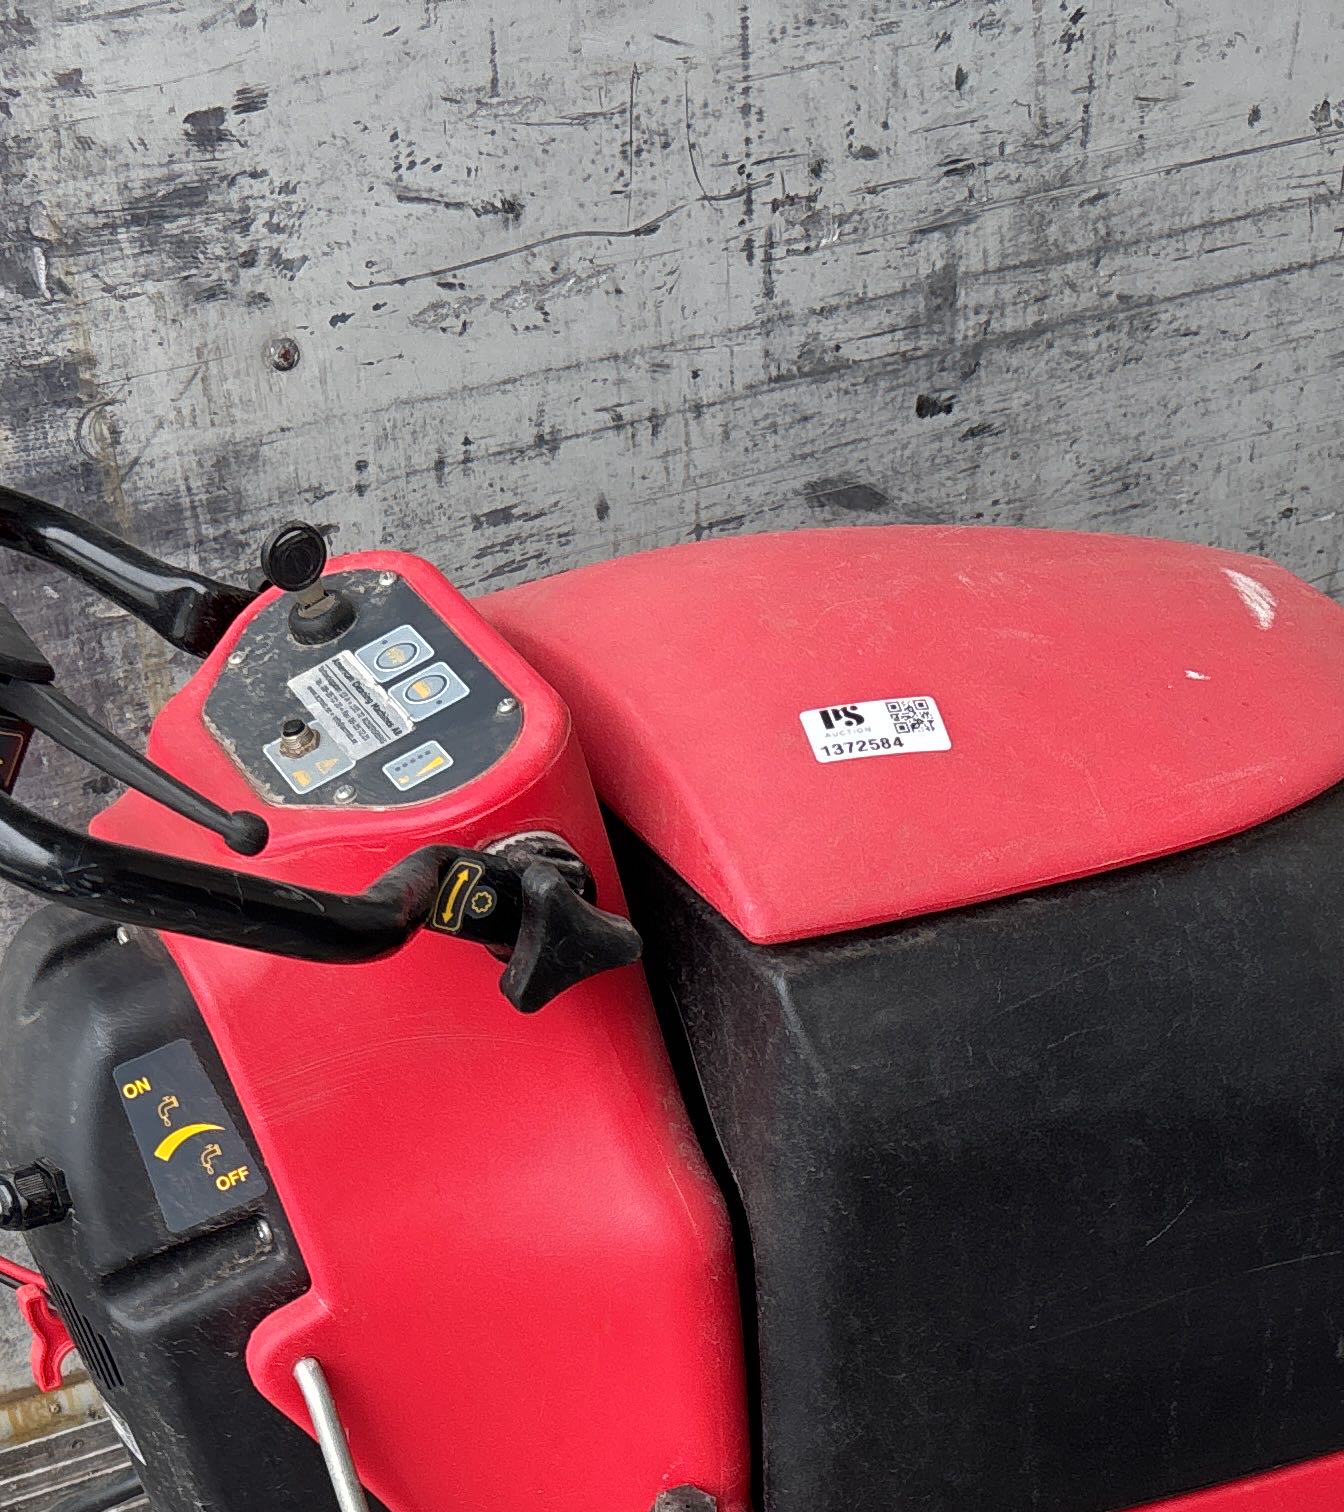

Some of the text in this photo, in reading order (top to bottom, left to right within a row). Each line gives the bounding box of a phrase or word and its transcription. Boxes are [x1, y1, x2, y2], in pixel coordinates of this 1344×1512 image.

[824, 726, 872, 738] AUCTION
[820, 736, 905, 757] 1372584
[122, 1076, 152, 1099] ON
[215, 1165, 250, 1191] OFF
